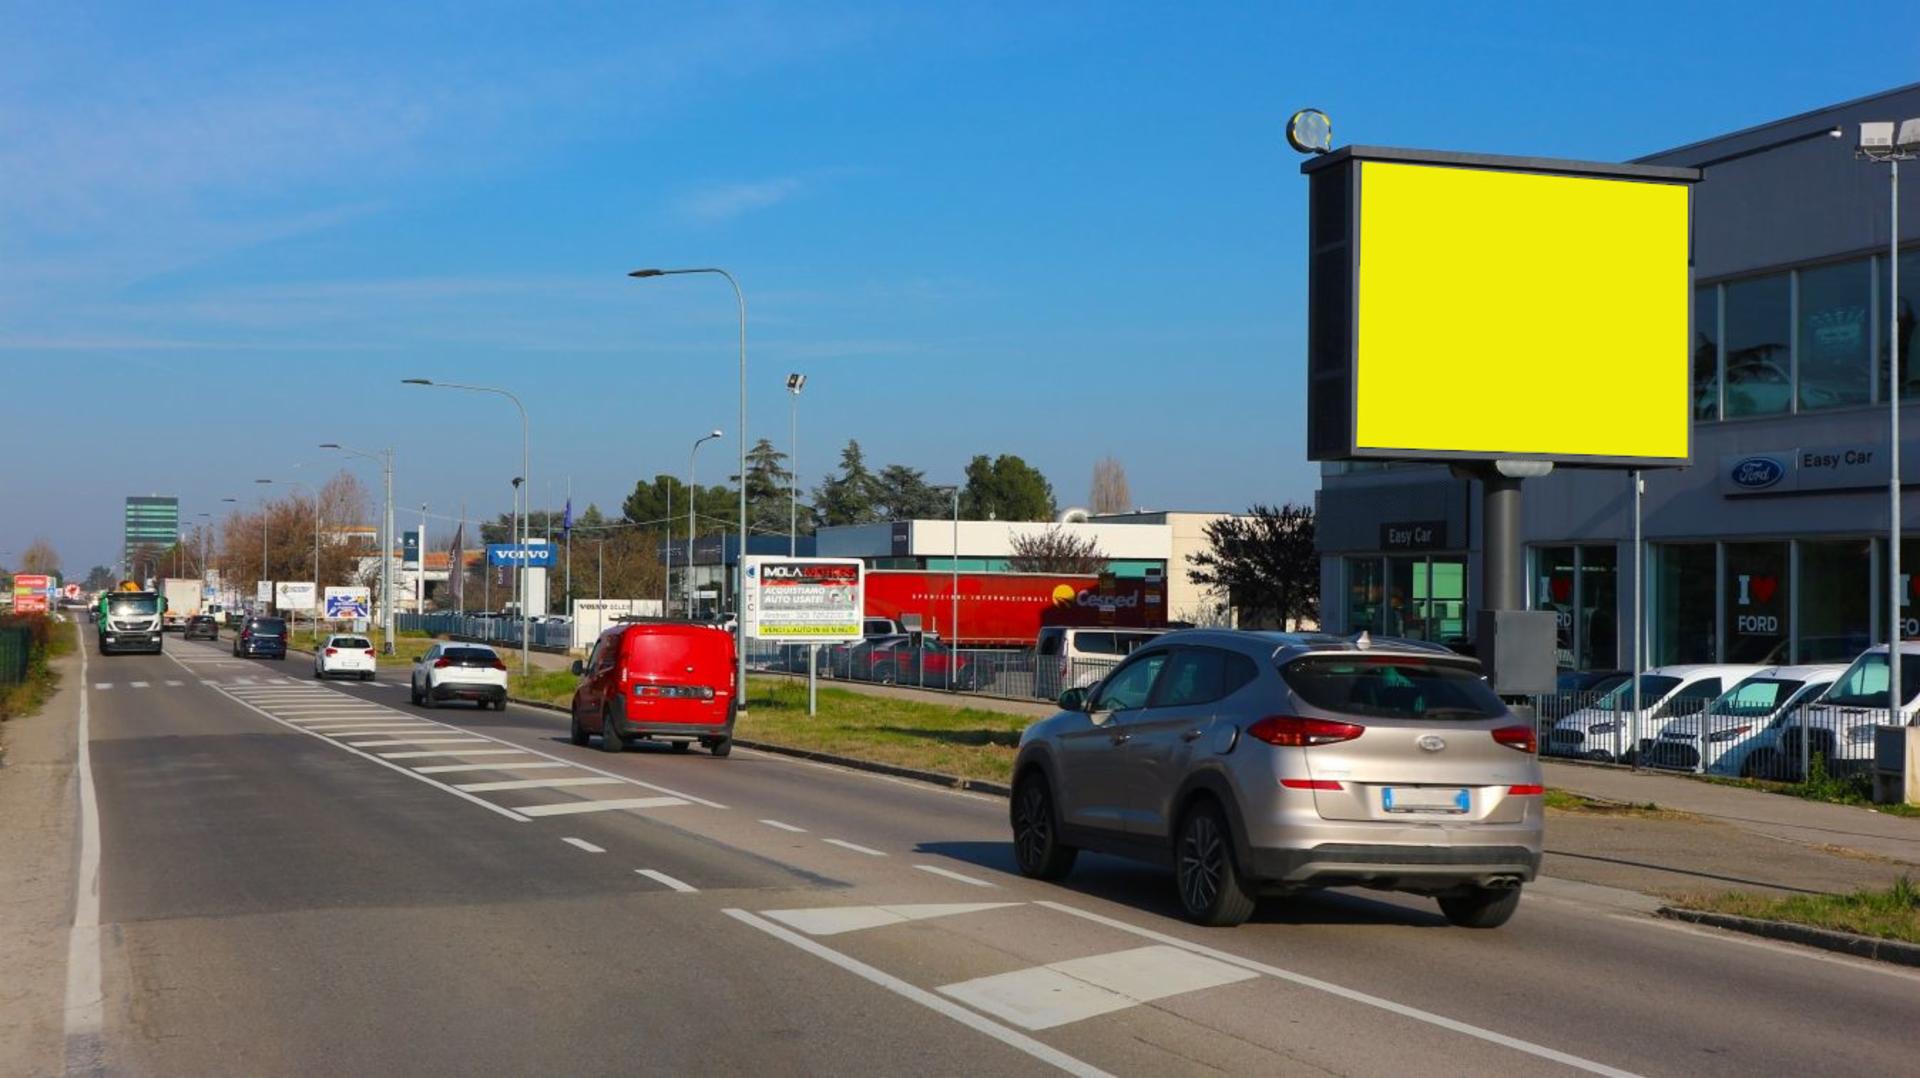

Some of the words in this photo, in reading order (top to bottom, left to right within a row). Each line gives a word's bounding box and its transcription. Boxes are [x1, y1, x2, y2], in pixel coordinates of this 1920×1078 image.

[1804, 453, 1840, 469] Easy
[1845, 450, 1873, 465] Car
[1739, 463, 1770, 481] Ford
[1389, 528, 1412, 547] Easy
[1415, 527, 1432, 543] Car
[496, 550, 549, 559] VOLVO
[764, 566, 803, 577] IMOLA
[1739, 574, 1750, 605] I
[1738, 615, 1777, 632] FORD
